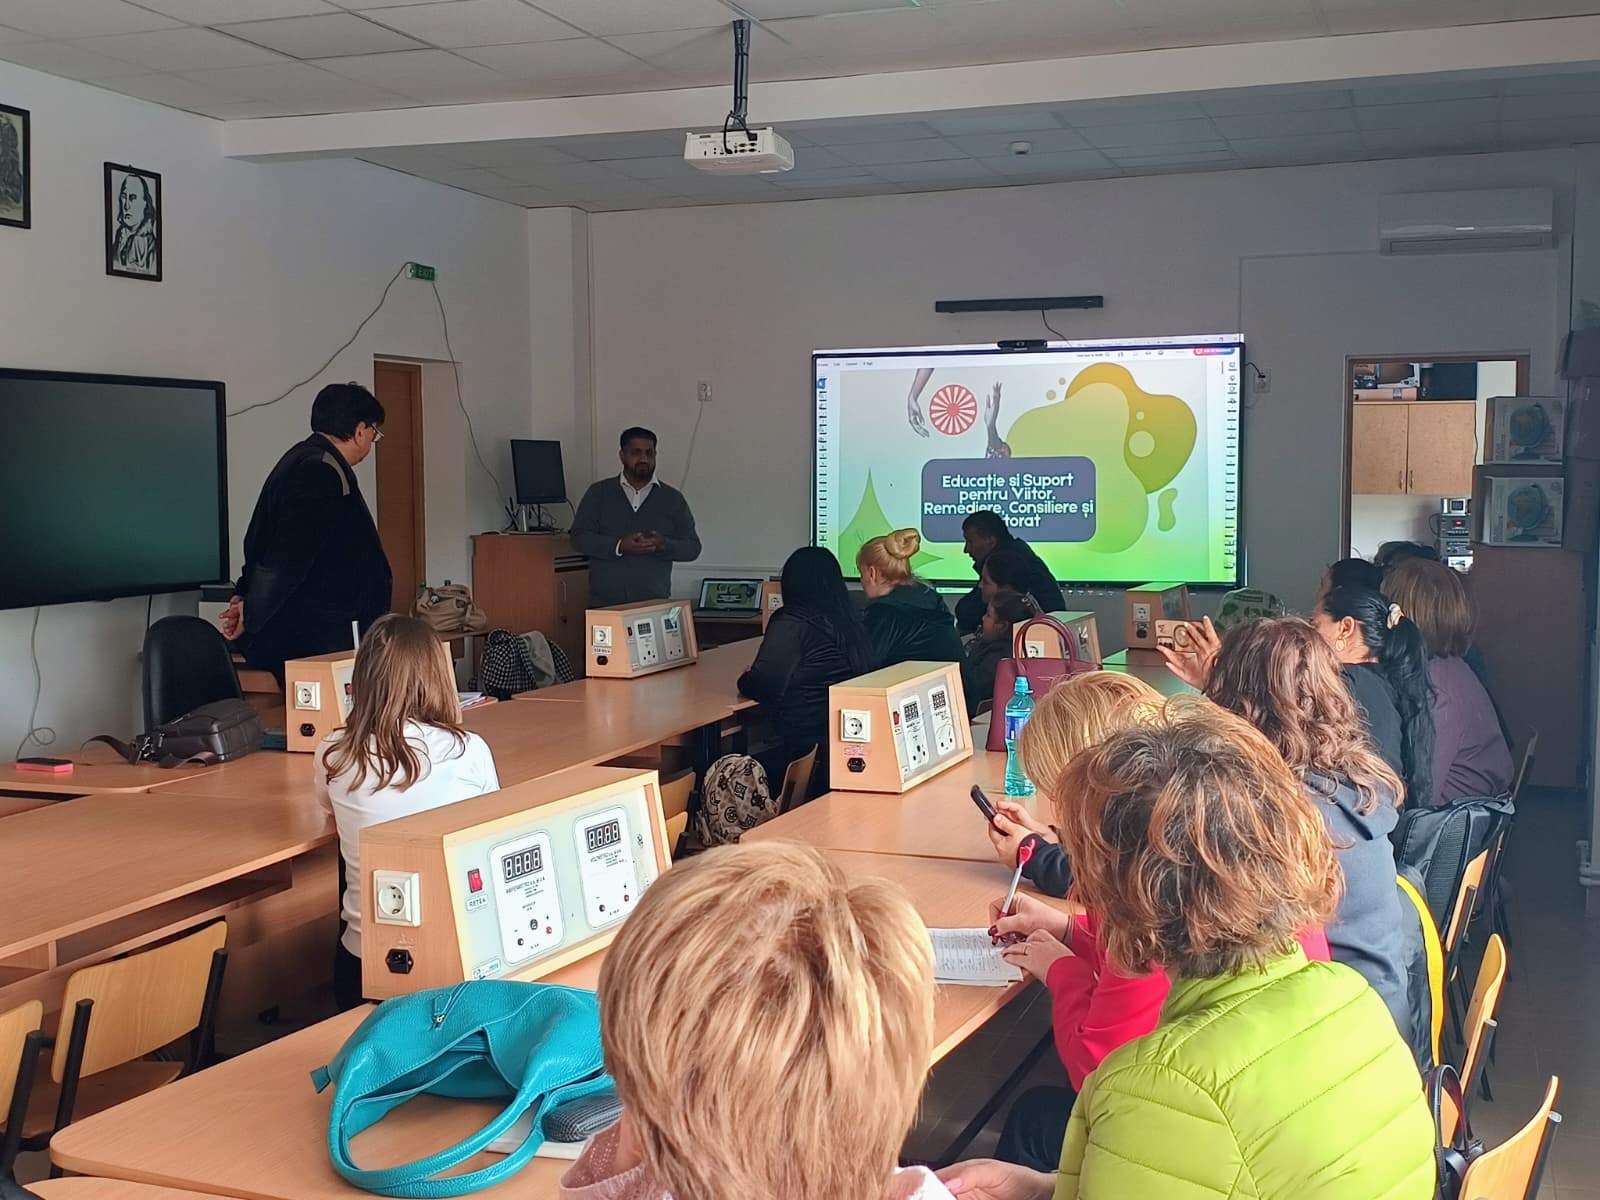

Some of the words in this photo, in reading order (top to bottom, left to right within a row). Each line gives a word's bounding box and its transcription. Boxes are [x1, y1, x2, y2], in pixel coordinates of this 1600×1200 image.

[1022, 472, 1074, 489] Suport
[959, 488, 1008, 503] pentru
[1011, 486, 1057, 500] Viitor.
[1008, 500, 1079, 514] Consiliere
[1002, 514, 1042, 528] torat
